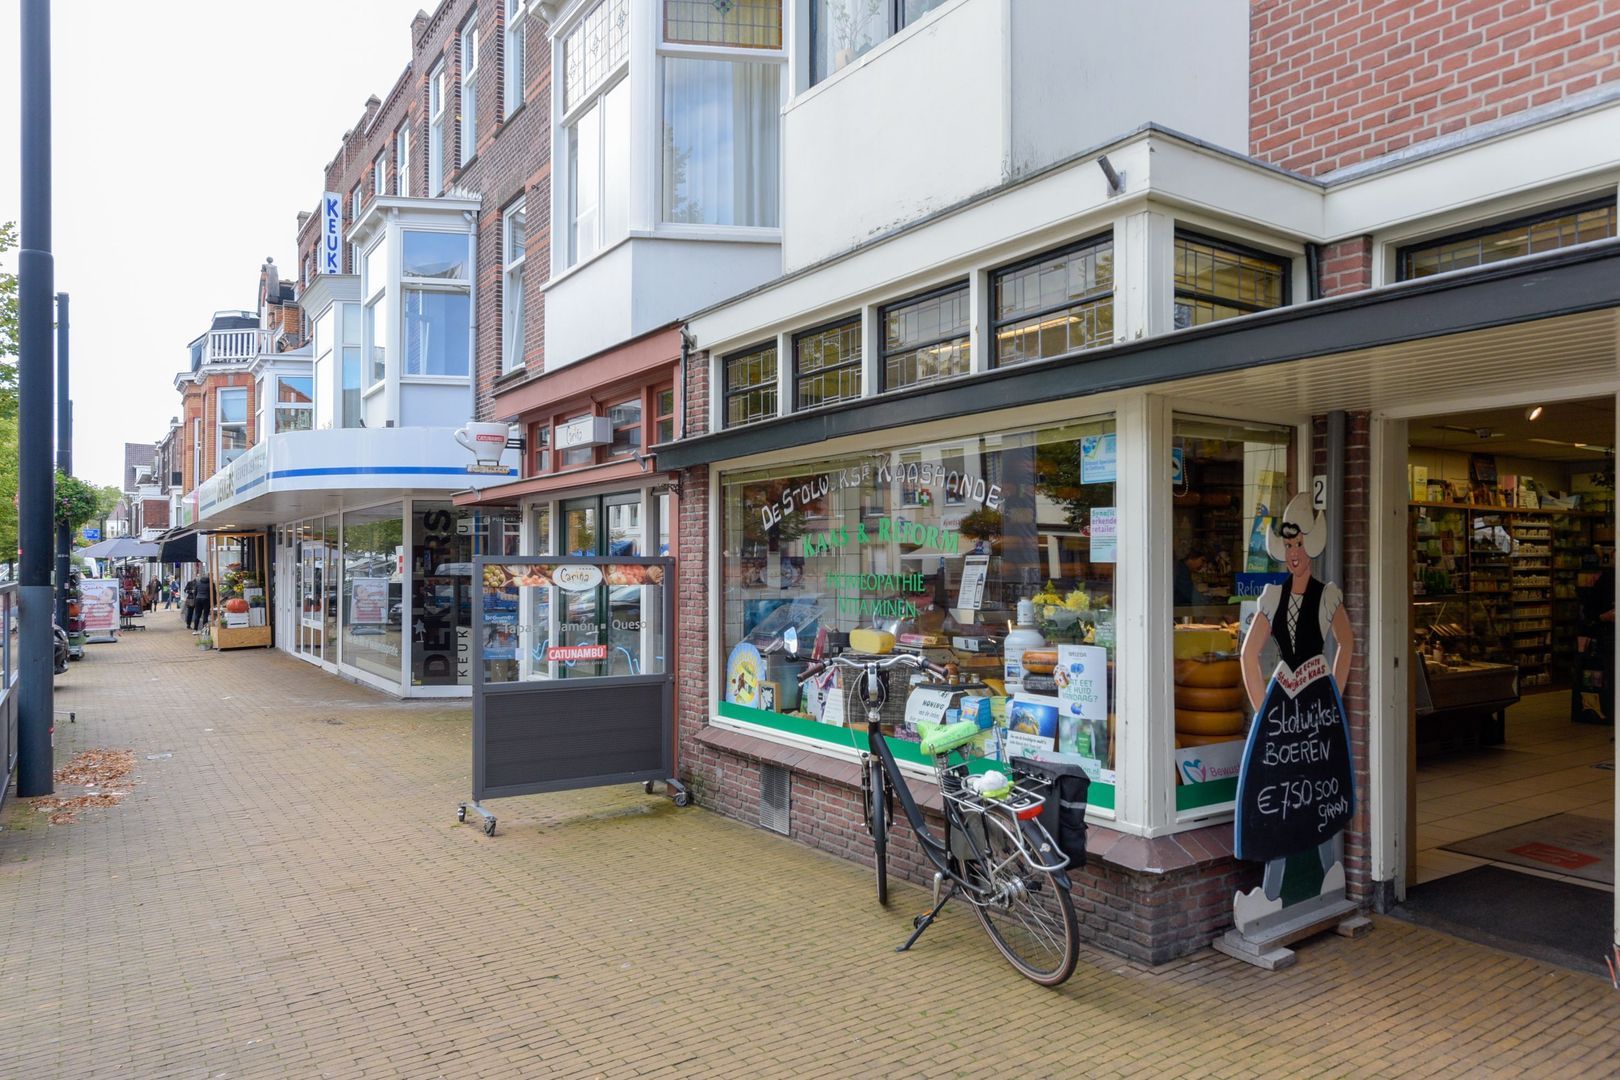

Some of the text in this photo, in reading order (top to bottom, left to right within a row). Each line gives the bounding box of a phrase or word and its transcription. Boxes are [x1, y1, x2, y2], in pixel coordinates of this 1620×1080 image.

[783, 462, 870, 516] STOLWKSE
[866, 450, 1004, 509] KAASHANDE
[1314, 480, 1323, 504] 2
[856, 522, 871, 545] &
[612, 619, 647, 630] Queso
[1308, 665, 1326, 681] KAAS
[1263, 739, 1331, 766] BOEREN
[1315, 777, 1339, 800] 500
